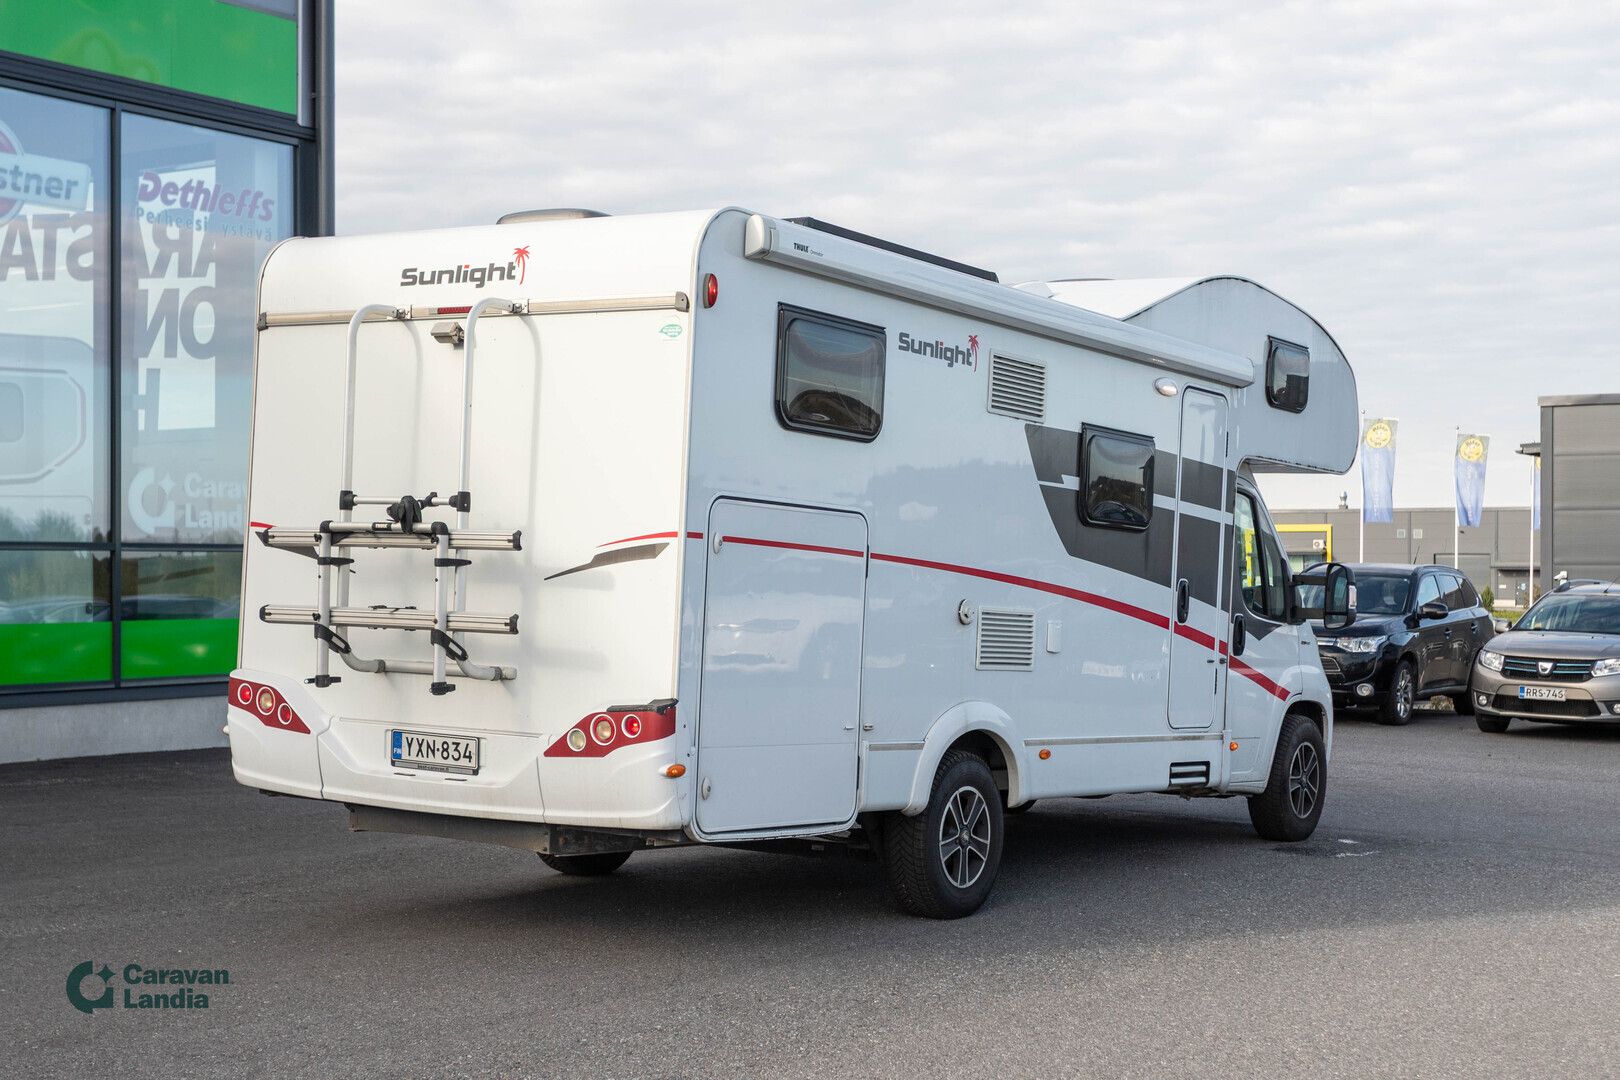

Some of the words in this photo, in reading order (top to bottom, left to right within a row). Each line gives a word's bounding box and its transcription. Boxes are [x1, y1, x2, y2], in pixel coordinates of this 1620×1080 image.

[137, 170, 275, 222] Dethleffs
[136, 206, 208, 232] Perheesi
[793, 242, 809, 253] THULE
[400, 262, 516, 288] Sunlight
[898, 332, 972, 368] Sunlight
[406, 736, 473, 763] YXN-834
